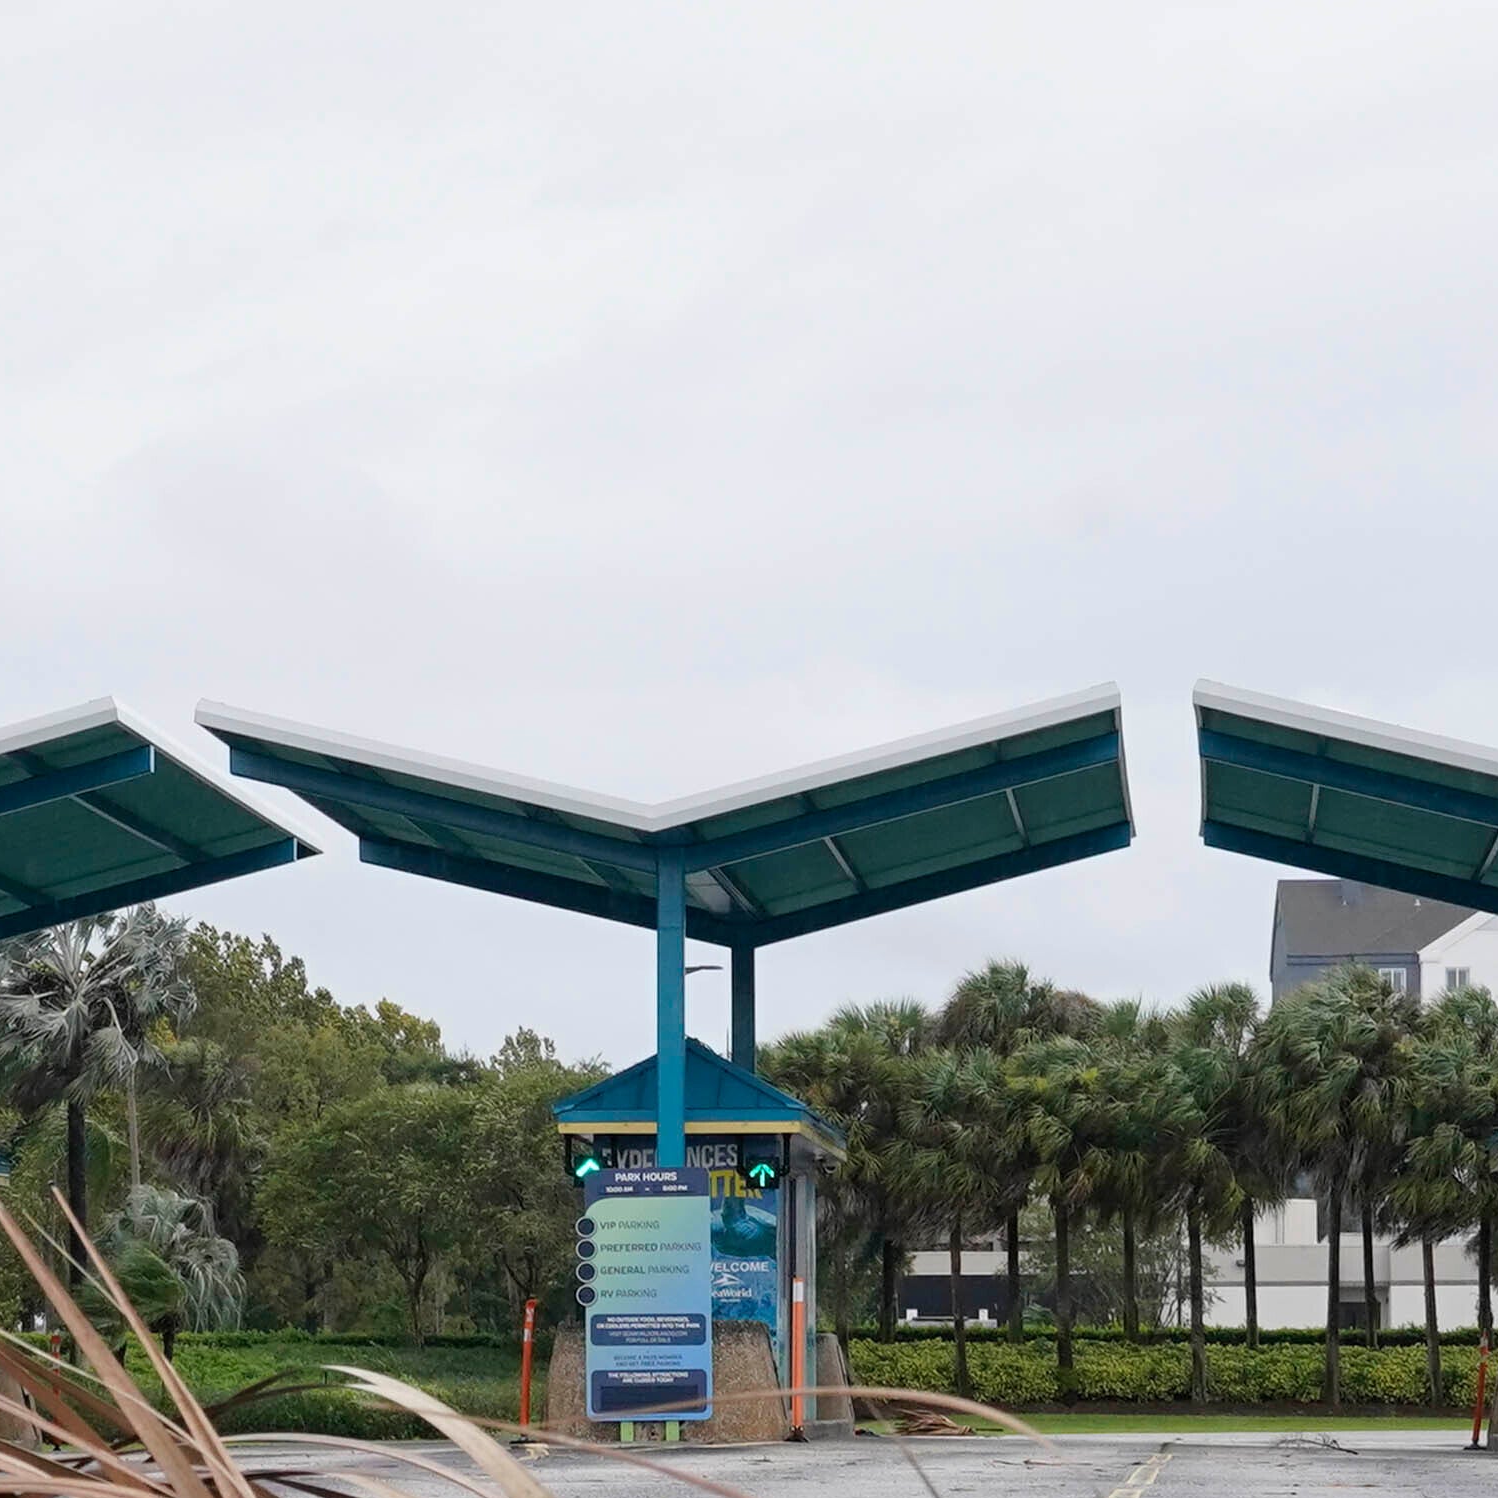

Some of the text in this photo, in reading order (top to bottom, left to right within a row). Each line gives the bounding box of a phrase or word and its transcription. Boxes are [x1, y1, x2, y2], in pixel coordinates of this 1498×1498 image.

[602, 1144, 738, 1169] PENCES
[615, 1172, 677, 1182] PARK HOURS
[710, 1169, 763, 1199] TTE
[600, 1221, 660, 1230] VIP PARKING
[600, 1242, 701, 1252] PREFERRED PARKING
[600, 1265, 689, 1275] GENERAL PARKING
[710, 1261, 769, 1272] ELCOME
[600, 1288, 657, 1298] RV PARKING
[711, 1288, 752, 1297] eaWorld
